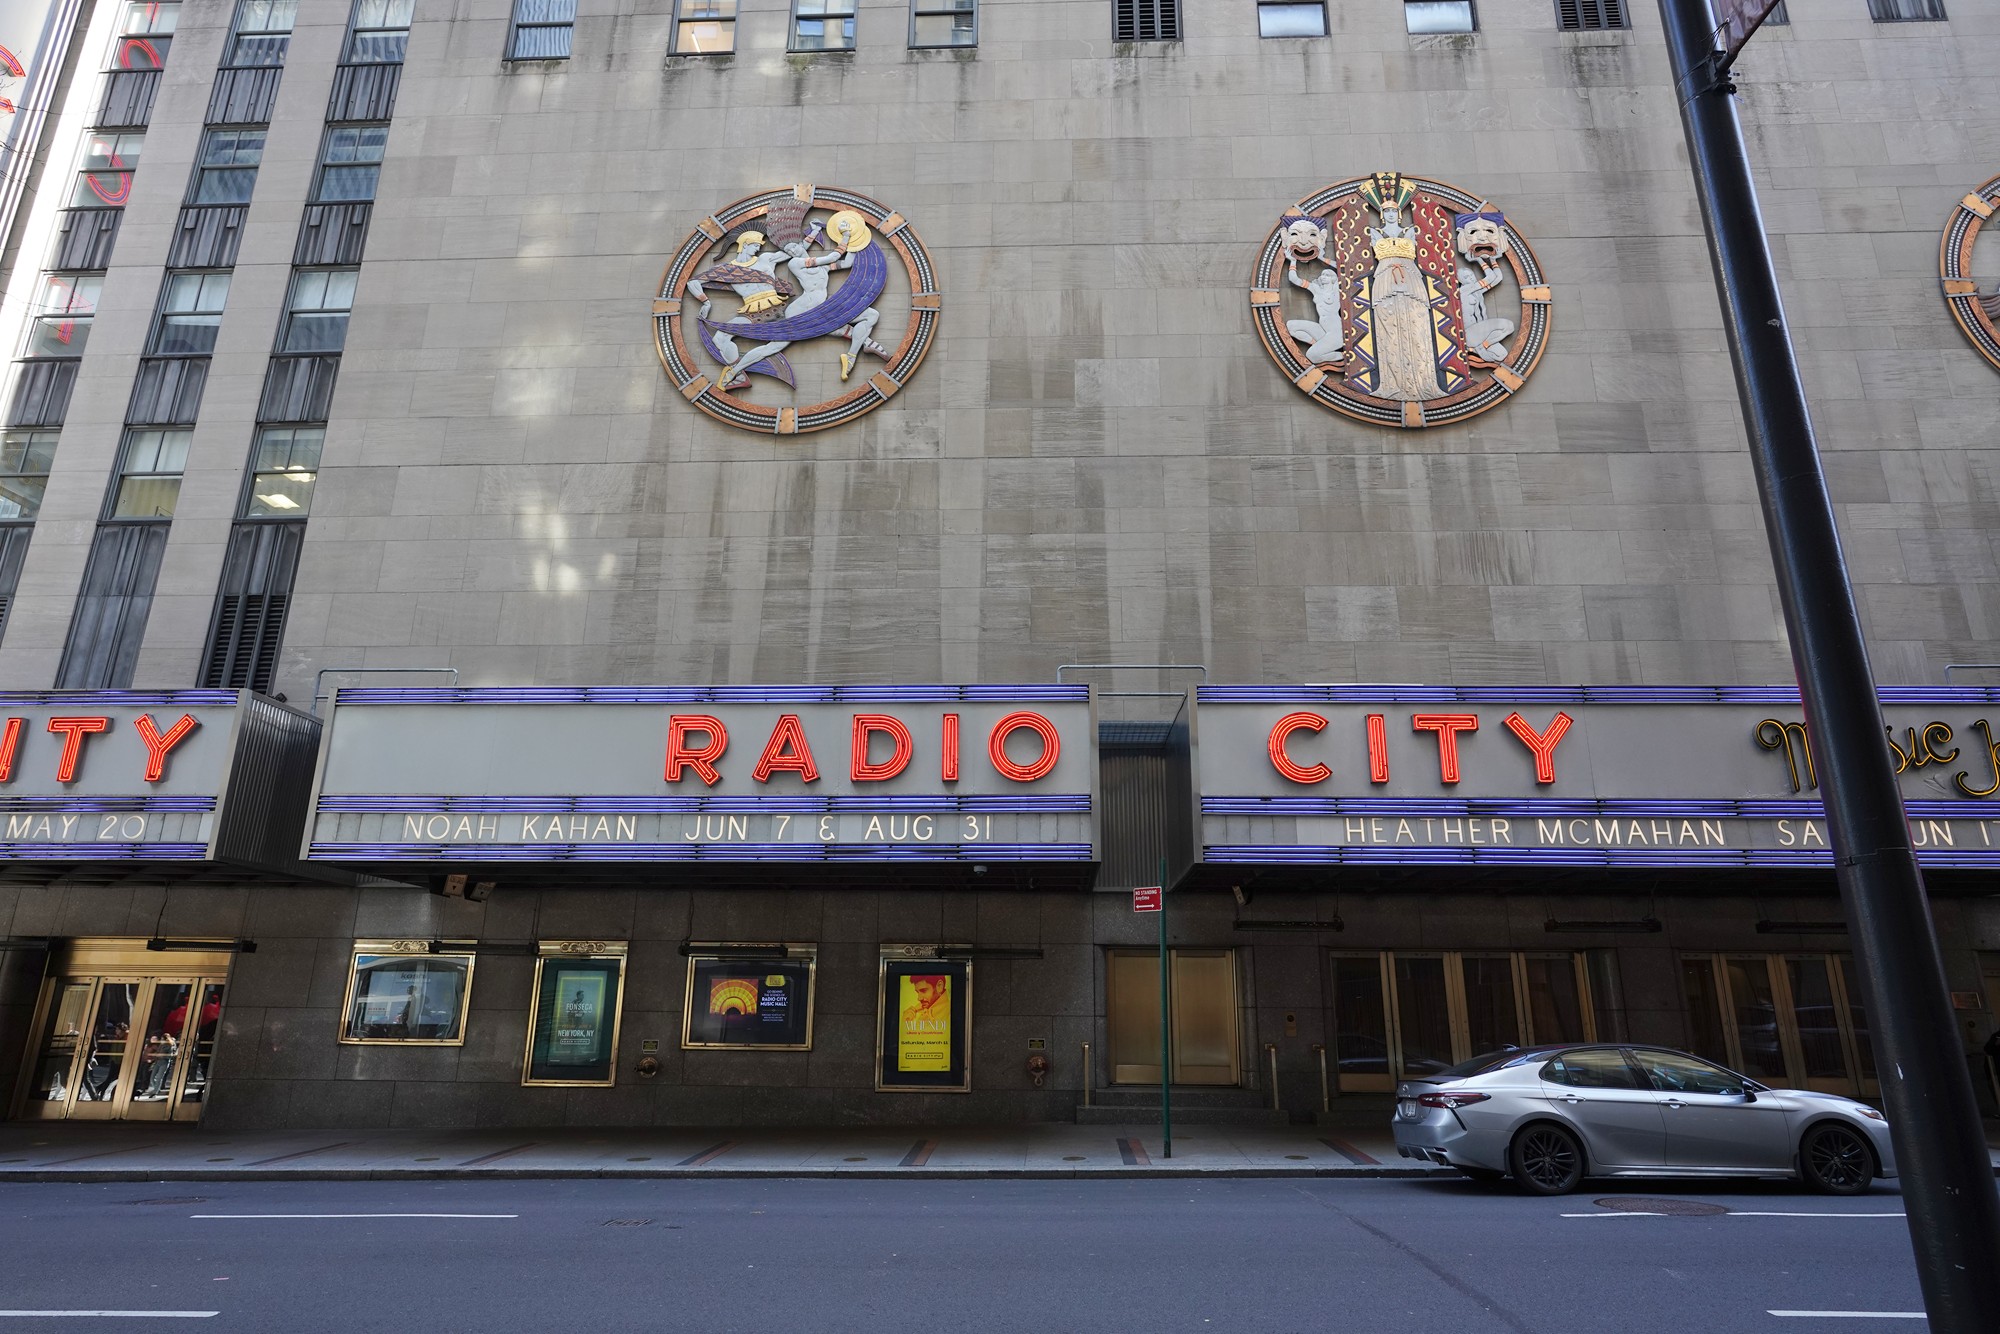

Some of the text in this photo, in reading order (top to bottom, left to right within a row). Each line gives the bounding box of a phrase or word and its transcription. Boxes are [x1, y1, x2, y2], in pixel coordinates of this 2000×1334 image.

[664, 711, 1061, 787] RADIO
[1267, 711, 1575, 785] CITY
[6, 815, 146, 840] MAY 20
[404, 815, 991, 841] NOAH KAHAN JUN 7 & AUG 31
[1345, 818, 1511, 845] HEATHER
[1537, 818, 1725, 846] MCMAHAN
[1777, 819, 1825, 847] SA
[1912, 820, 1954, 847] UN
[566, 1003, 593, 1011] FONSECA
